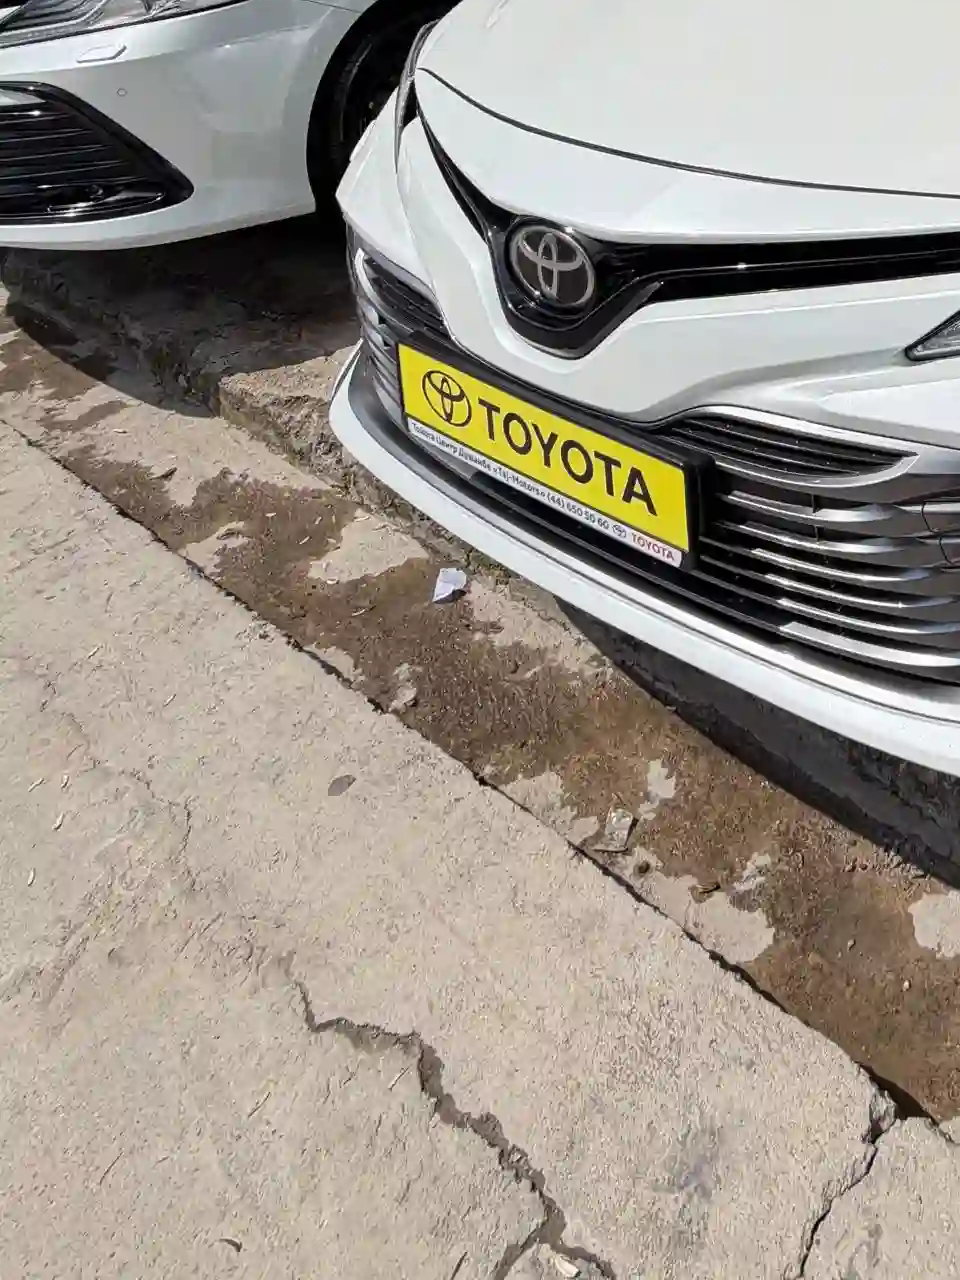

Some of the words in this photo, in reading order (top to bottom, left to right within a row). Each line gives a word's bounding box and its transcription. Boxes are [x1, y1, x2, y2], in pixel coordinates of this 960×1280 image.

[477, 397, 658, 517] TOYOTA
[547, 490, 564, 509] (44)
[566, 503, 583, 517] 650
[584, 511, 596, 524] 50
[597, 518, 609, 530] 60
[631, 533, 675, 561] TOYOTA
